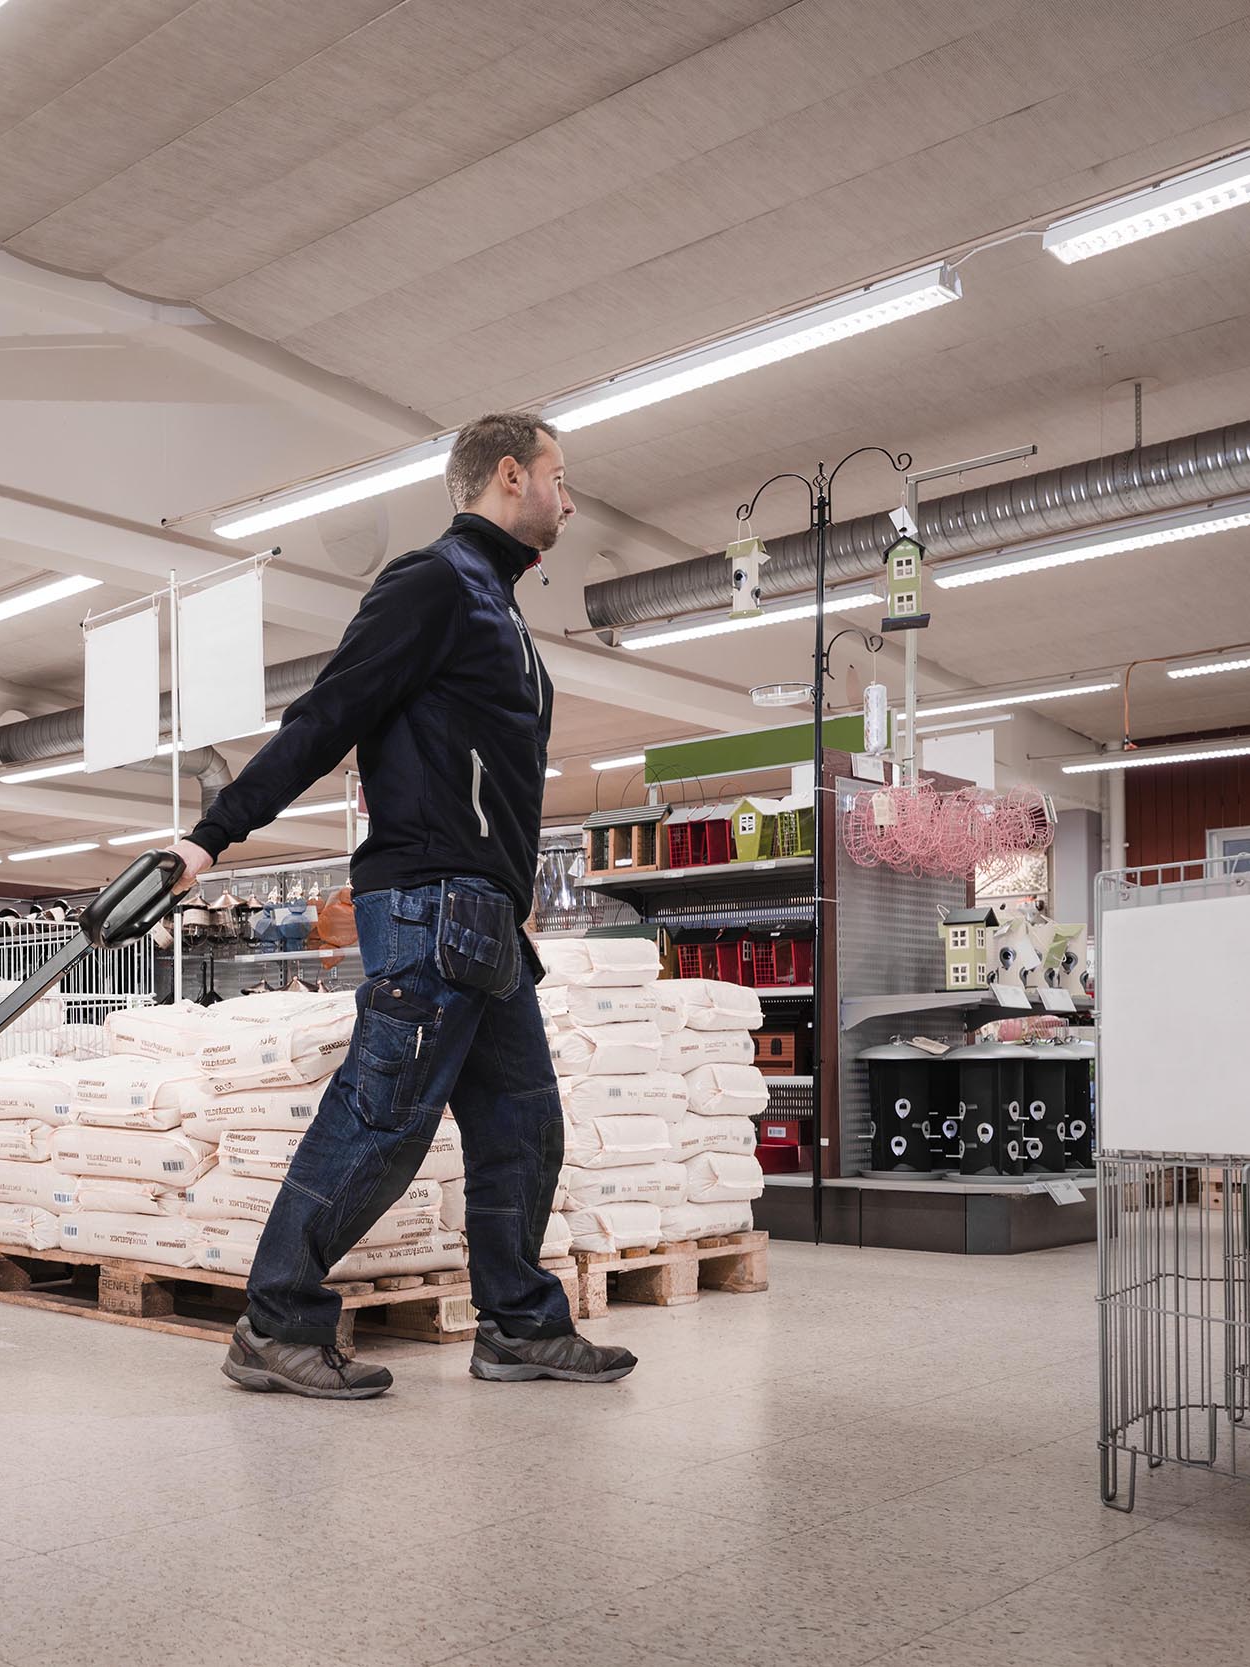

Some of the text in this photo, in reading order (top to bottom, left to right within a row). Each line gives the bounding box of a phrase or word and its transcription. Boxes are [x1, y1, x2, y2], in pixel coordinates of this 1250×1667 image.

[204, 1106, 245, 1116] VILDFÅGELMIX
[258, 1105, 266, 1115] kg
[287, 1138, 298, 1147] 10
[408, 1188, 429, 1200] 10 kg
[389, 1246, 434, 1258] VILDFÅGELMIX
[101, 1279, 130, 1293] RENFE
